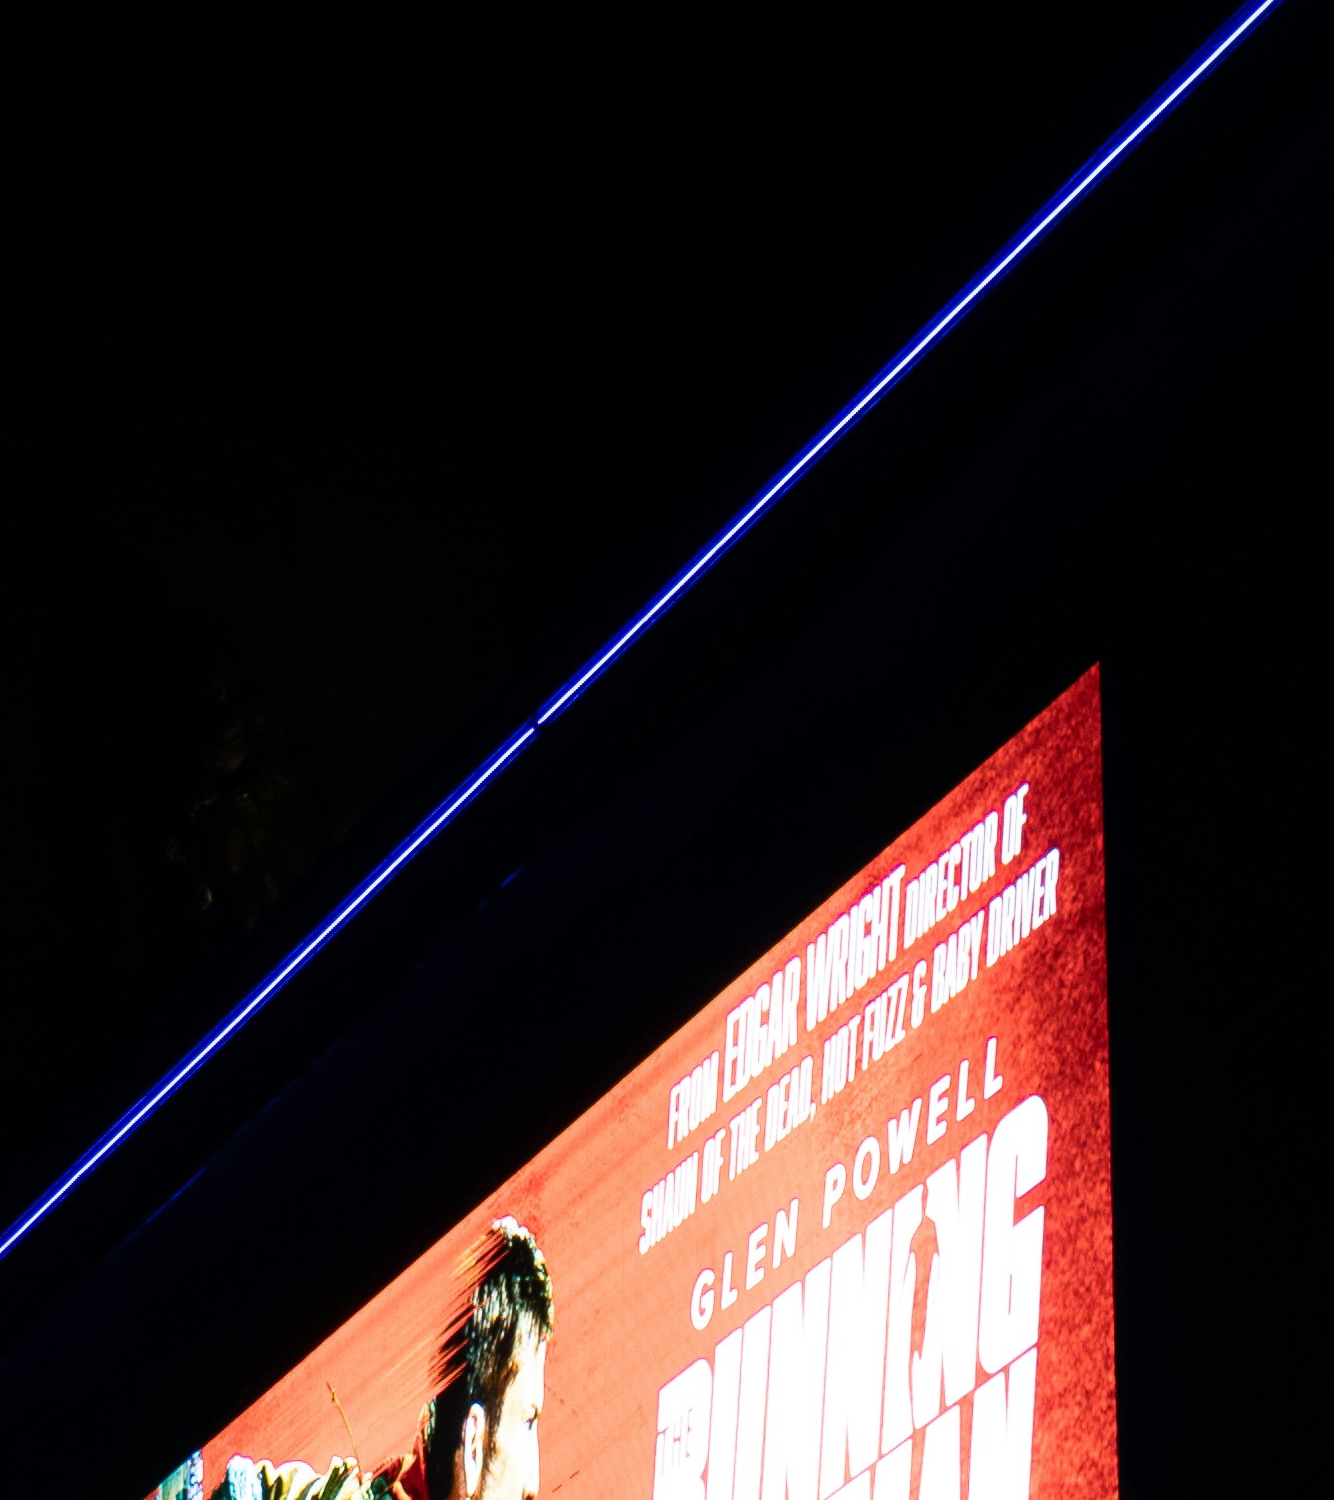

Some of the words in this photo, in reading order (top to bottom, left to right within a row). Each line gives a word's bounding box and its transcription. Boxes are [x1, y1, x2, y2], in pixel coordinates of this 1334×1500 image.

[638, 1168, 697, 1255] SHAUN
[701, 1136, 726, 1204] OF
[729, 1097, 761, 1181] THE
[764, 1054, 816, 1152] DEAD,
[821, 1013, 861, 1106] HOT
[862, 972, 909, 1071] FUZZ
[910, 959, 927, 1028] &
[930, 909, 985, 1014] BABY
[985, 847, 1059, 967] DRIVER
[668, 1051, 719, 1150] FROM
[722, 956, 802, 1103] EDGAR
[806, 864, 906, 1032] WRIGHT
[903, 811, 997, 948] DIRECTOR
[1002, 783, 1029, 864] OF
[690, 1198, 799, 1331] GLEN
[822, 1035, 1004, 1229] POWELL
